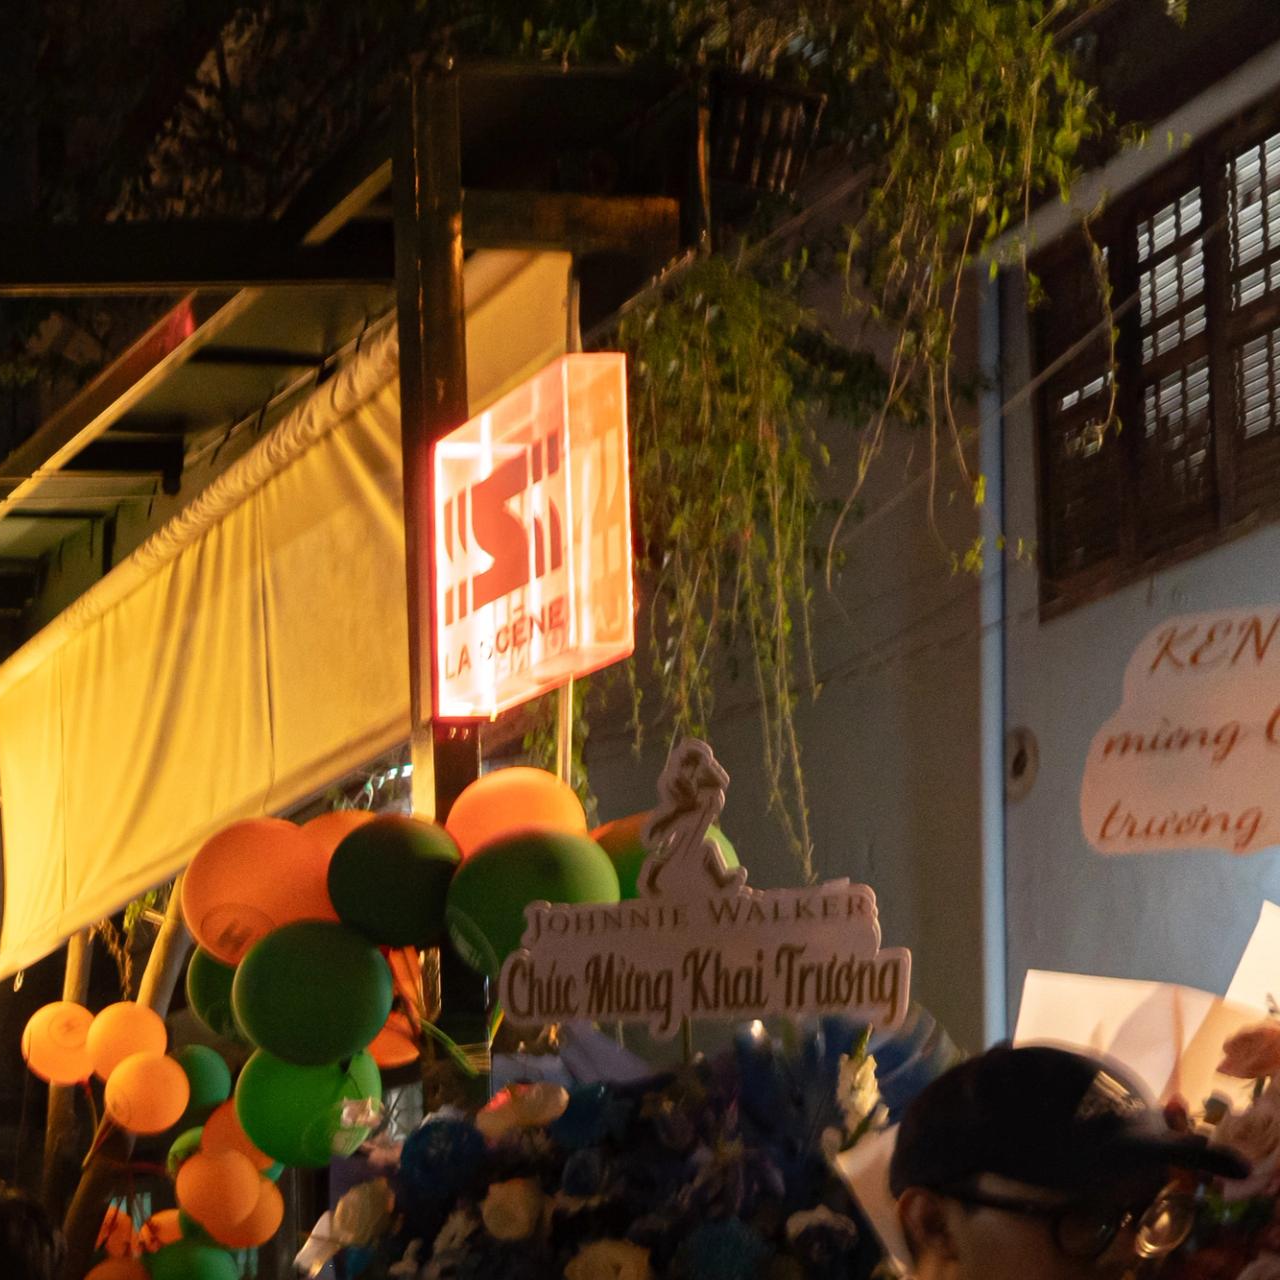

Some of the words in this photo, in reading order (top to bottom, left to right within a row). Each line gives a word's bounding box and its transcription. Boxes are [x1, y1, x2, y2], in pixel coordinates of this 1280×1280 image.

[445, 643, 472, 680] LA
[534, 904, 690, 943] JOHNNIE
[708, 895, 869, 926] WALKER
[506, 955, 580, 1019] Chúc
[681, 948, 770, 1013] Khai
[775, 942, 902, 1027] Trương
